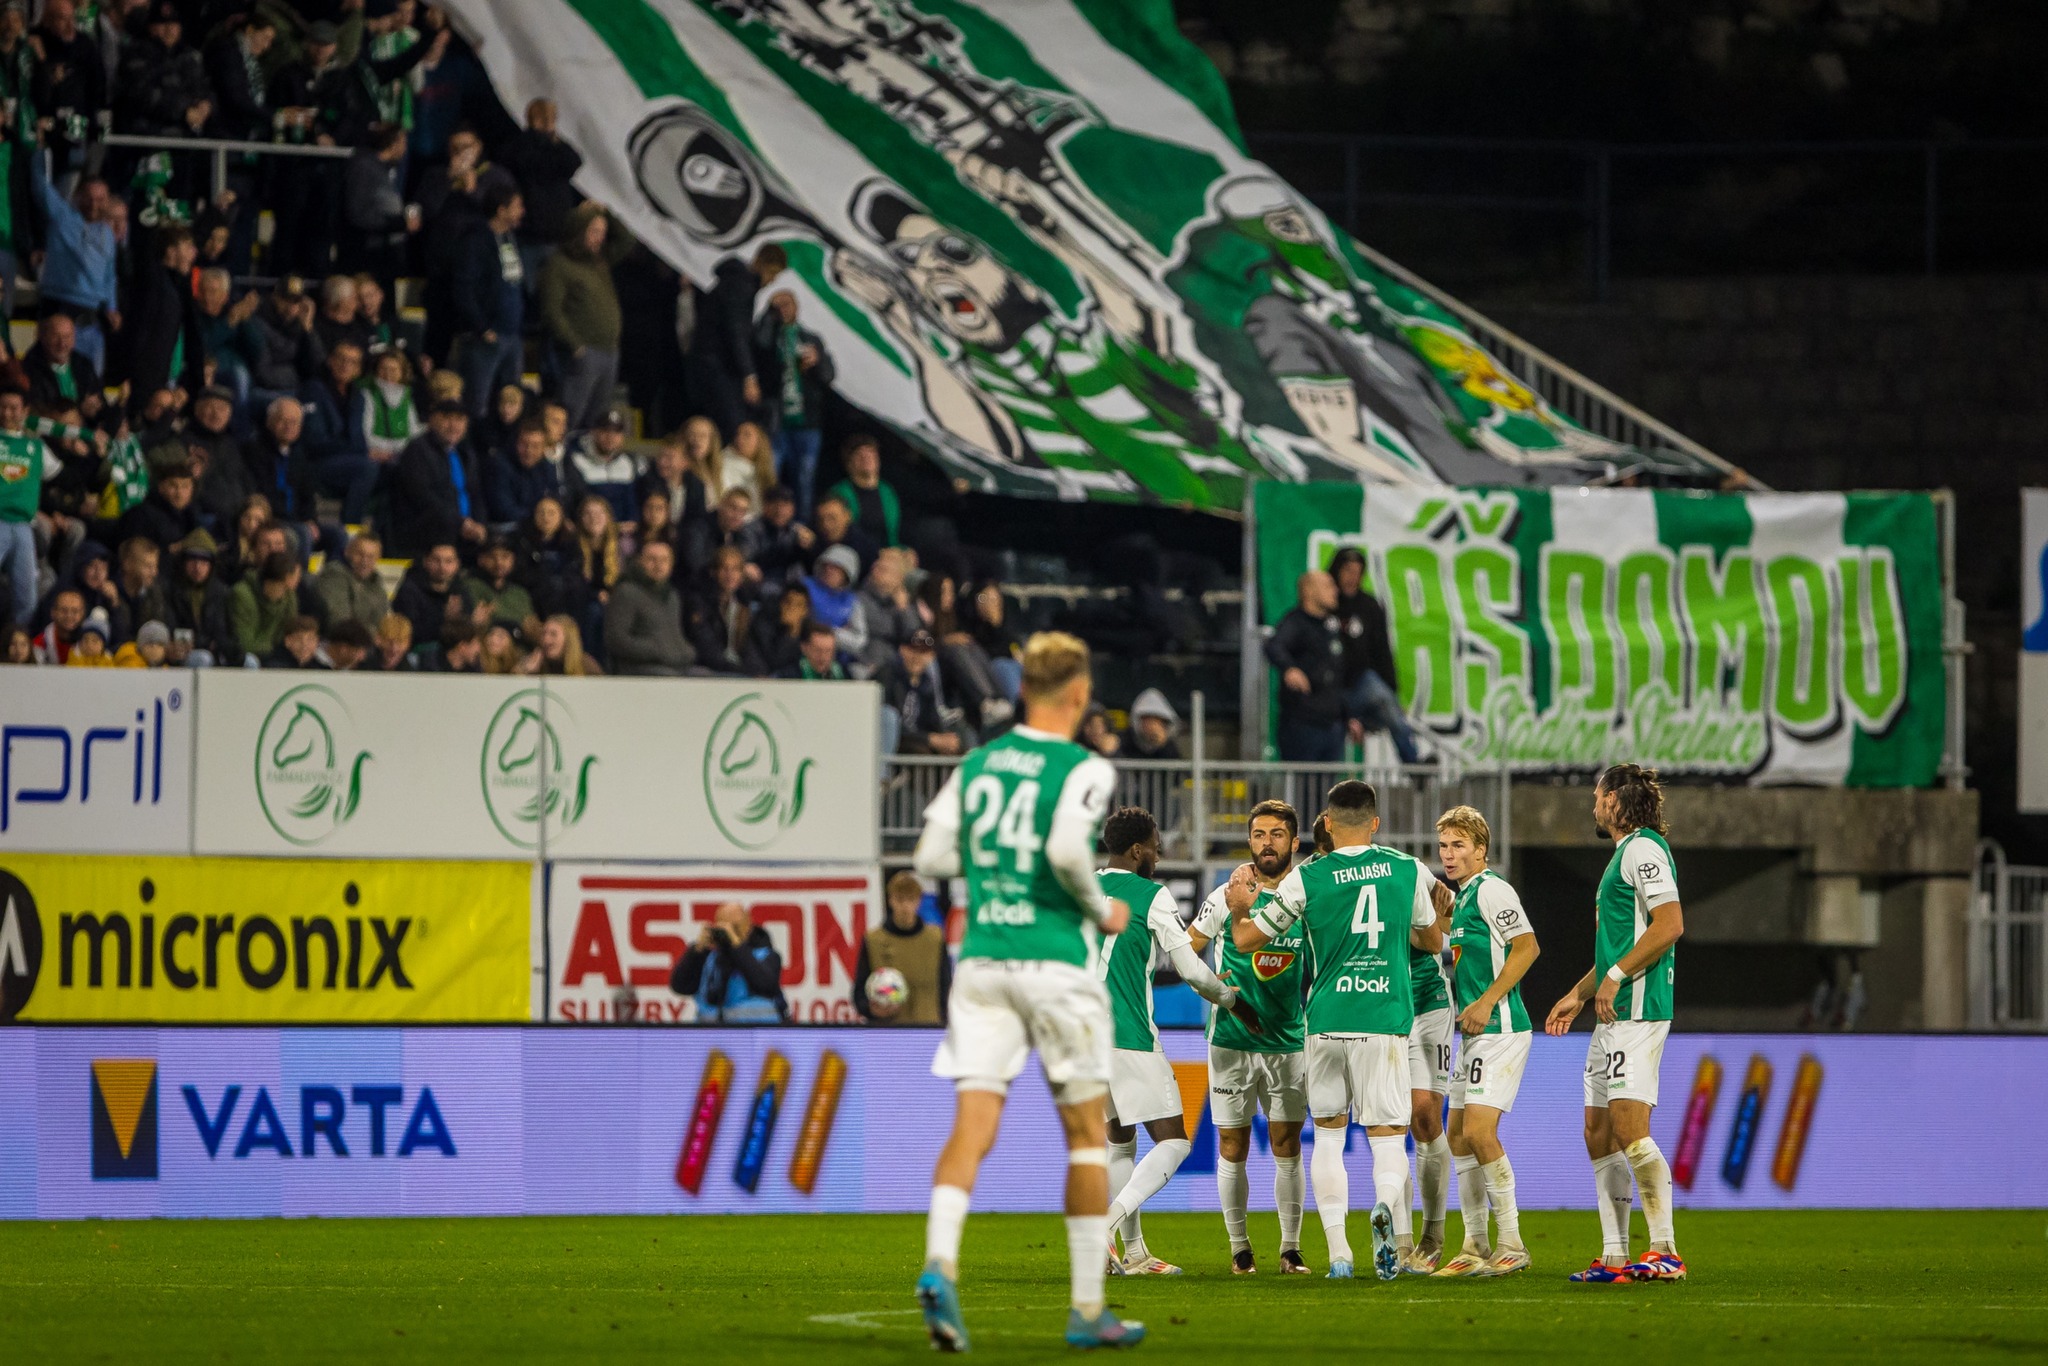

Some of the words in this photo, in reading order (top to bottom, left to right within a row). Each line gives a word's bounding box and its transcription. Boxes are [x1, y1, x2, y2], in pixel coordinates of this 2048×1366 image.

[1310, 492, 1535, 735] ÁŠ
[1540, 545, 1907, 735] DOMOV
[965, 774, 1042, 873] 24
[1332, 862, 1392, 884] TEKIJAŠKI
[59, 878, 415, 990] micronix
[1351, 884, 1385, 949] 4
[1258, 955, 1283, 967] MOL
[1437, 1044, 1450, 1072] 18
[1470, 1057, 1483, 1084] 6
[1606, 1050, 1626, 1080] 22
[180, 1085, 458, 1159] VARTA
